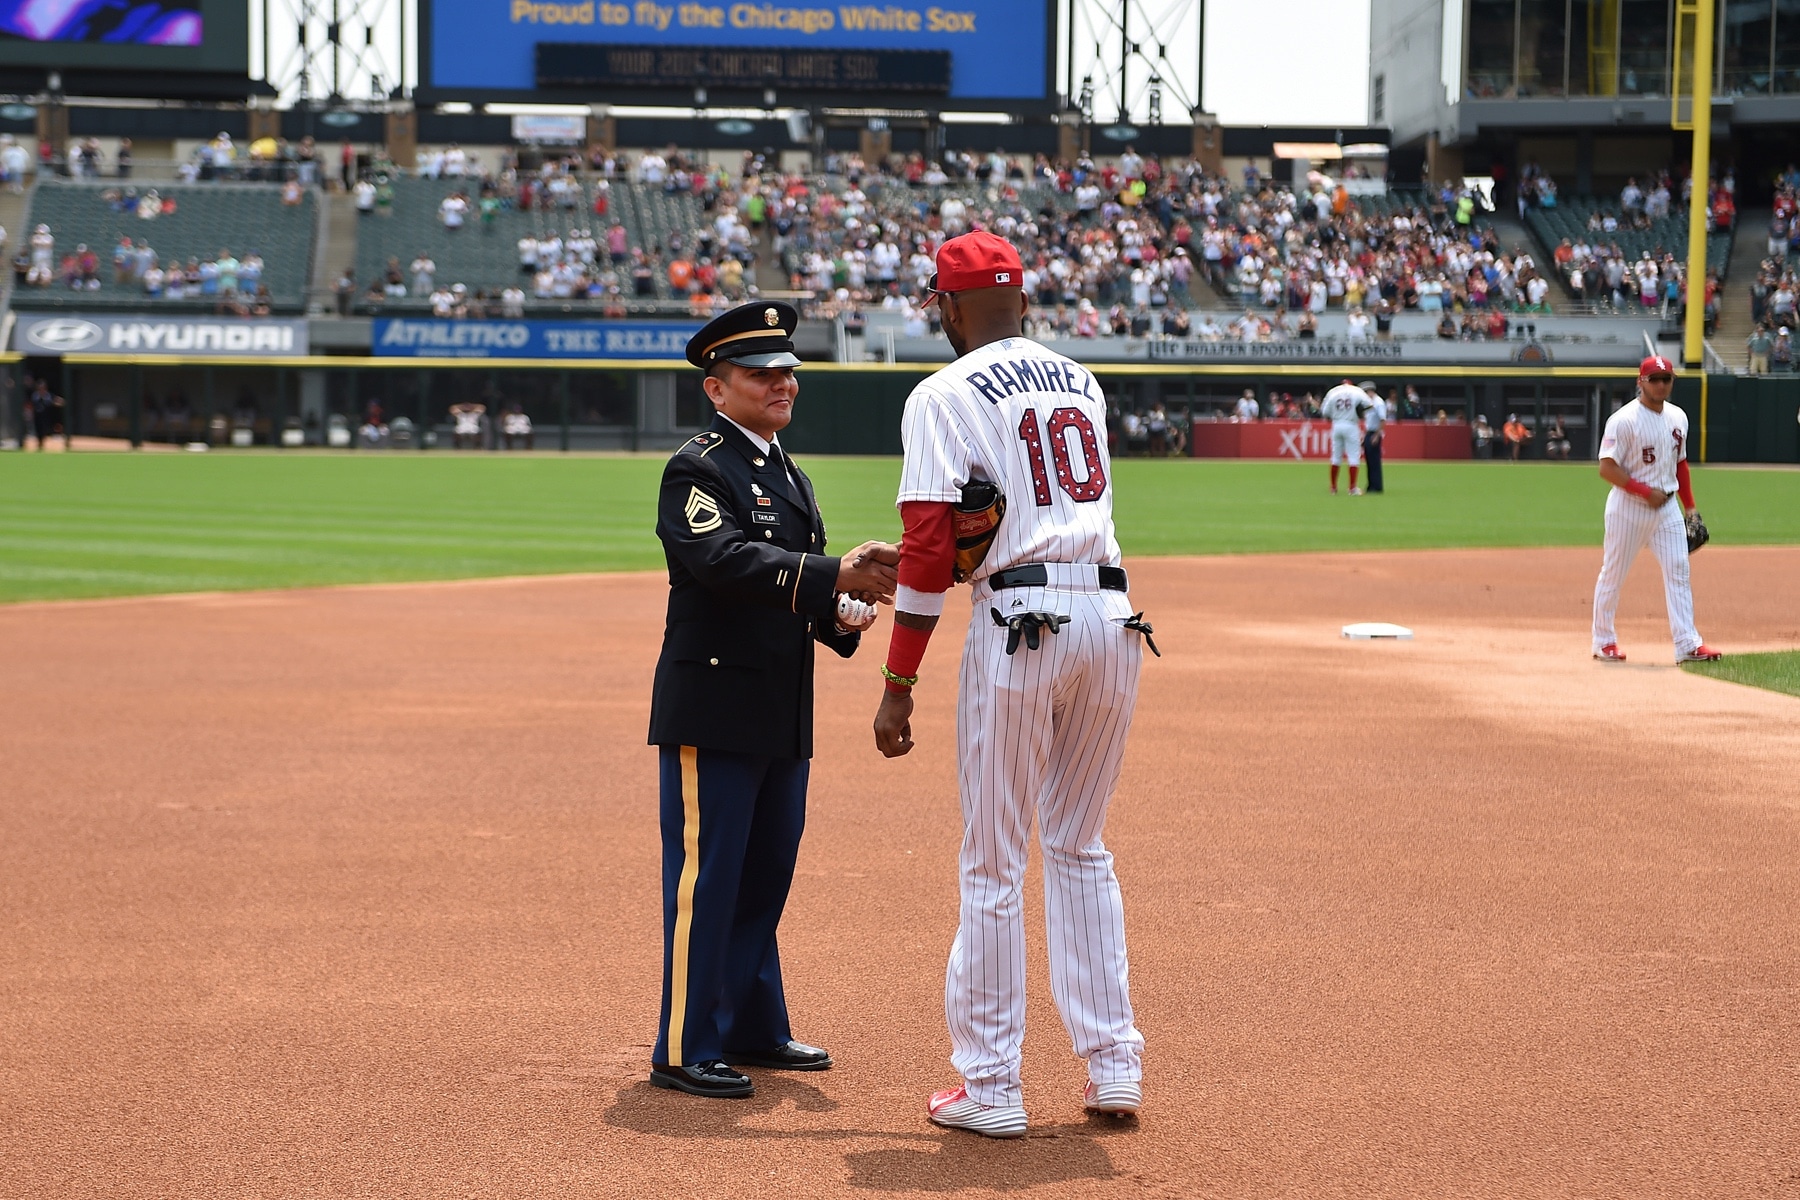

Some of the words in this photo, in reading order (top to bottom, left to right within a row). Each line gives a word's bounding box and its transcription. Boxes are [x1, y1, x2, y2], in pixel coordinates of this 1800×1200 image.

[511, 0, 595, 25] Proud
[601, 3, 630, 26] to
[635, 3, 673, 31] fly
[679, 4, 725, 28] the
[729, 4, 835, 34] Chicago
[839, 6, 922, 31] White
[926, 7, 977, 32] Sox
[607, 51, 655, 75] YOUR
[708, 53, 782, 78] CHICAGO
[788, 55, 838, 80] WHITE
[843, 56, 879, 80] SOX
[109, 323, 294, 349] HYUNDAI
[545, 330, 602, 352] THE
[605, 330, 697, 353] RELIE
[1251, 343, 1302, 357] SPORTS
[1308, 344, 1337, 357] BAR
[1353, 344, 1402, 358] PORCH
[965, 358, 1096, 405] RAMIREZ
[1018, 406, 1107, 507] 10
[1642, 447, 1656, 464] 5
[757, 514, 776, 522] TAYLOR
